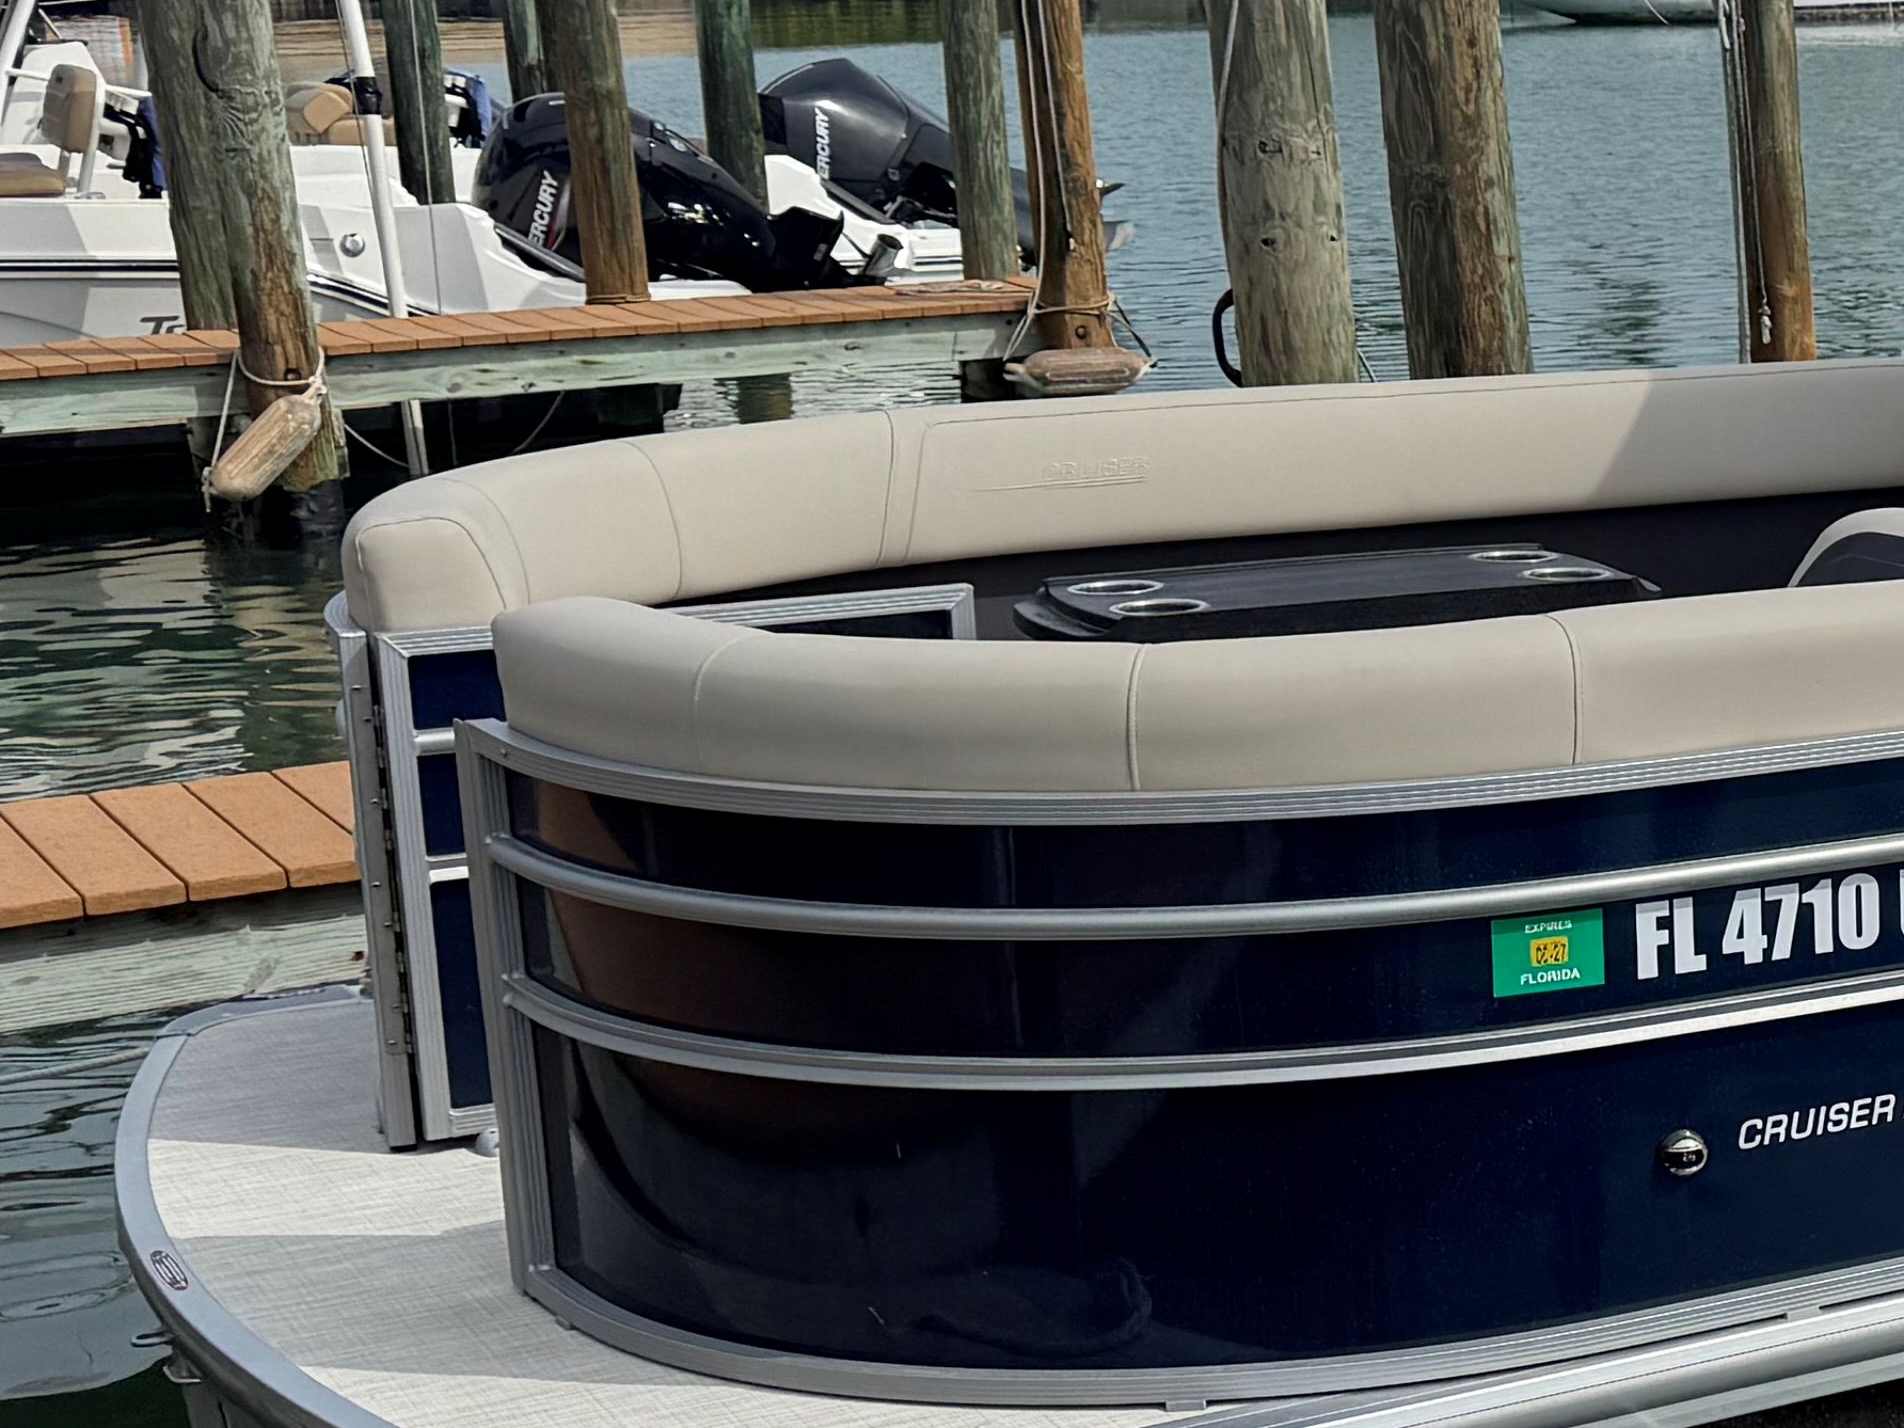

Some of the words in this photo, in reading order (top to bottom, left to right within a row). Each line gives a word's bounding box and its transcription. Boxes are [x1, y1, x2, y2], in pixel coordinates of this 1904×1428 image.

[815, 107, 831, 180] ERCURY
[528, 170, 558, 249] ERCURY
[1635, 896, 1707, 981] FL
[1722, 873, 1880, 965] 4710
[1520, 968, 1581, 985] FLORIDA
[1738, 1093, 1897, 1150] CRUISER
